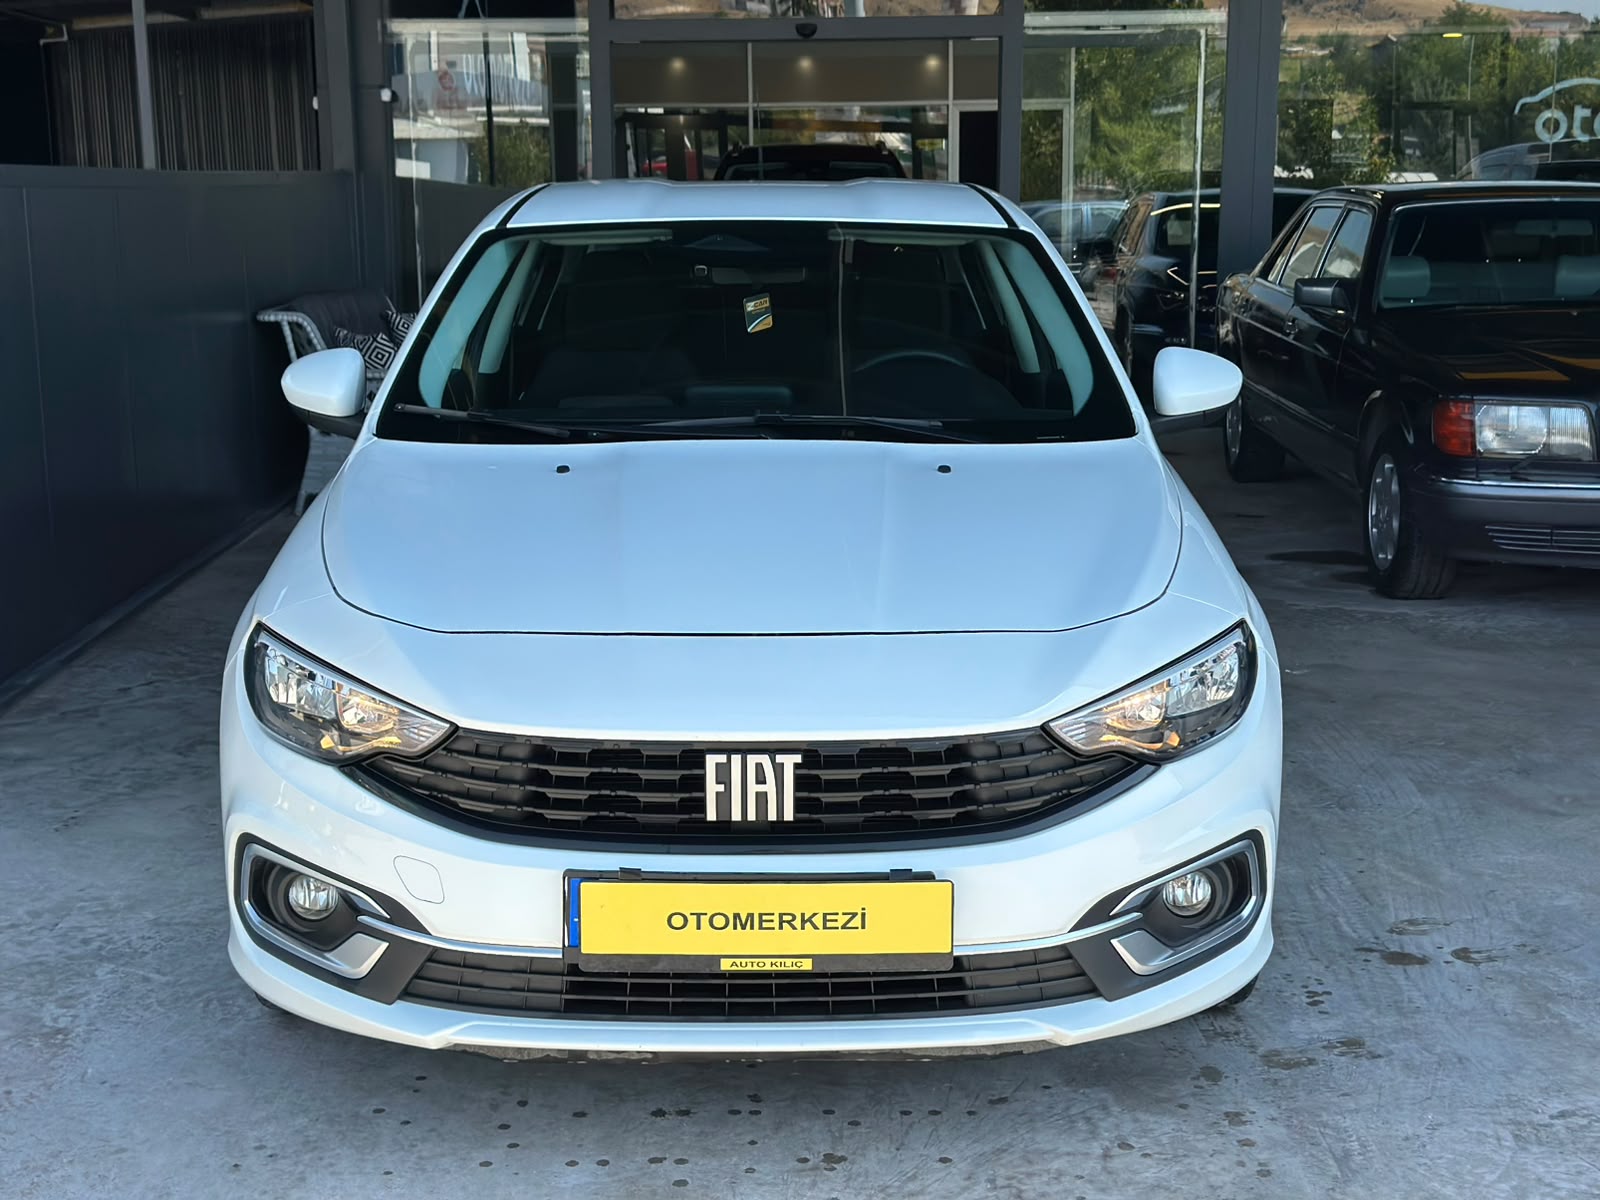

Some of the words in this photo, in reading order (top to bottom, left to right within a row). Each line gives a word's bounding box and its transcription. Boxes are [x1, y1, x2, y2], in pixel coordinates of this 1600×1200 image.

[1534, 104, 1600, 143] ot
[705, 753, 802, 821] FIAT
[666, 907, 867, 931] OTOMERKEZİ
[729, 960, 766, 968] AUTO
